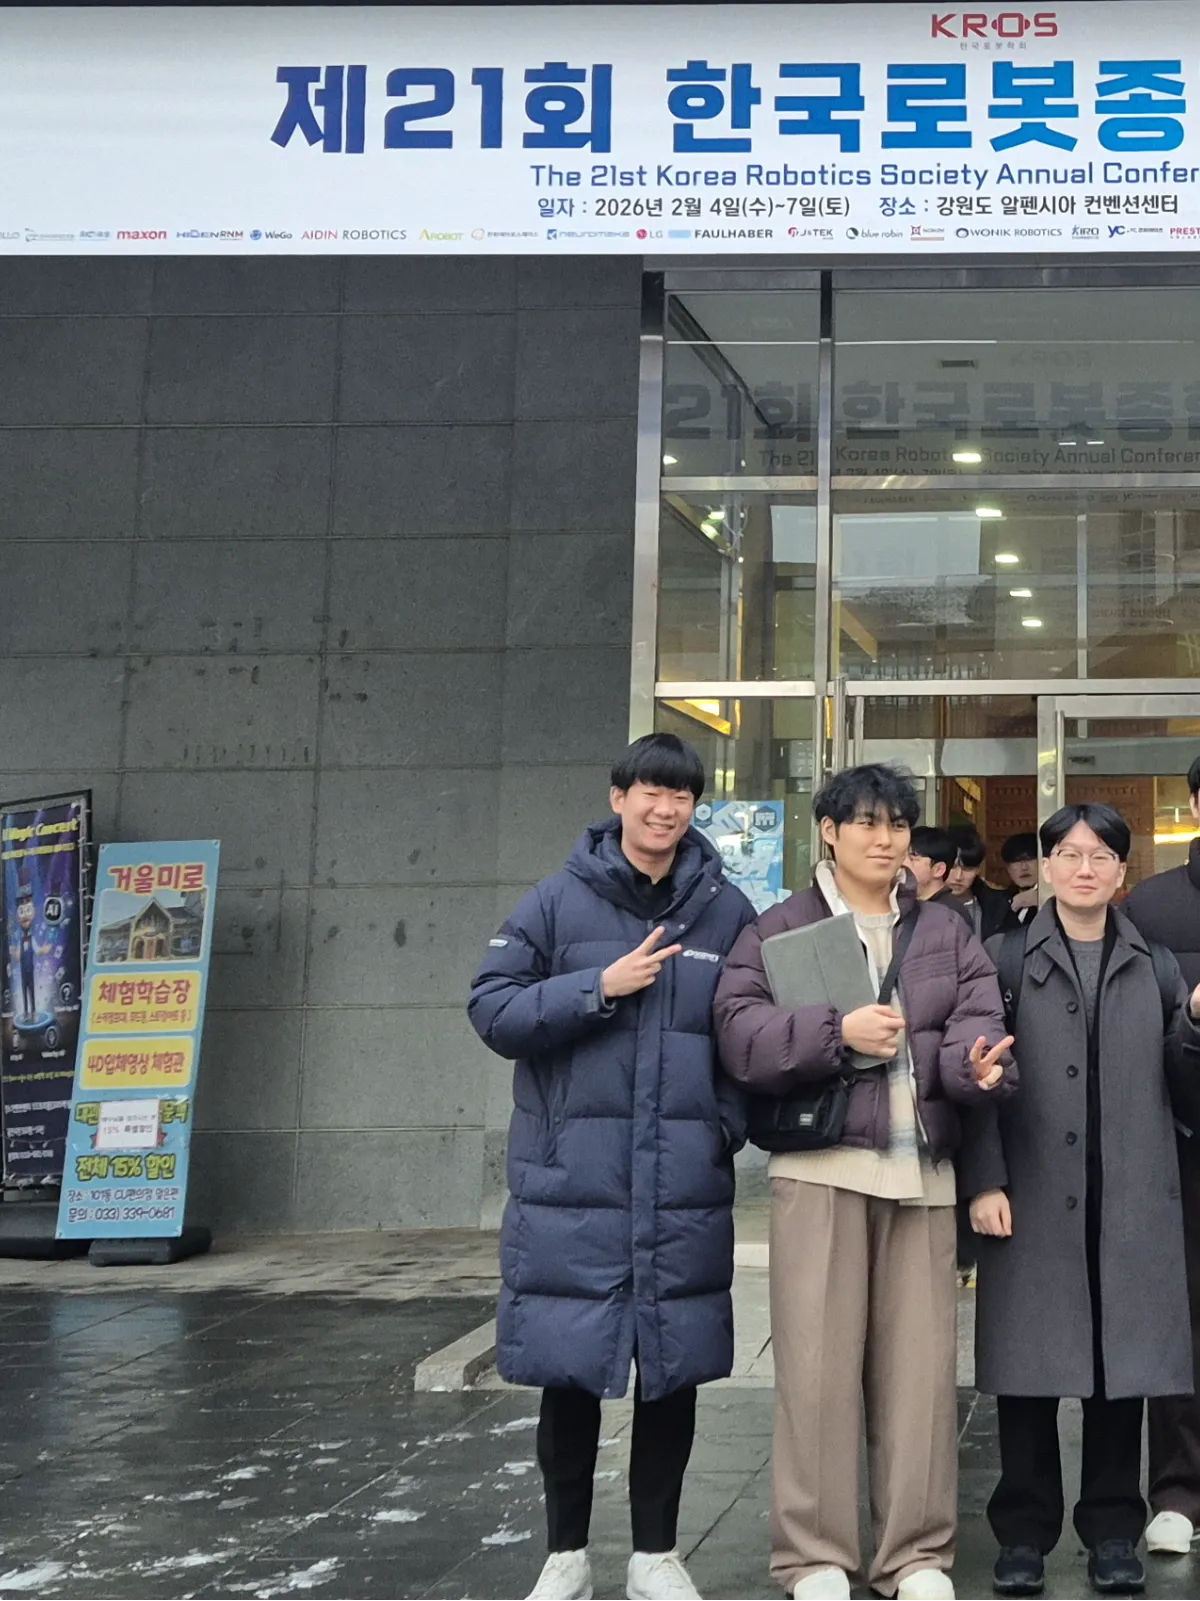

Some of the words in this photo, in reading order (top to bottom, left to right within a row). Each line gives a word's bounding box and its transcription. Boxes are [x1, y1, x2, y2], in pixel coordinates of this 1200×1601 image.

[931, 12, 1058, 39] KROS
[270, 62, 613, 153] 제21회
[529, 164, 582, 187] The
[590, 164, 647, 187] 21st
[656, 164, 737, 187] Korea
[746, 163, 871, 187] Robotics
[880, 162, 989, 190] Society
[995, 161, 1093, 185] Annual
[537, 197, 575, 218] 일자
[595, 198, 663, 217] 2026년
[671, 197, 702, 218] 2월
[709, 196, 850, 219] 4일(수)~7일(토)
[879, 197, 917, 216] 장소
[936, 196, 993, 216] 강원도
[1000, 195, 1077, 216] 알펜시아
[1084, 194, 1178, 215] 컨벤션센터
[116, 229, 168, 240] maxon
[264, 230, 293, 240] WeGo
[301, 229, 338, 240] AIDIN
[342, 229, 408, 240] ROBOTICS
[649, 230, 664, 239] LG
[694, 228, 774, 240] FAULHABER
[860, 229, 878, 238] blue
[880, 229, 904, 238] robin
[969, 228, 1011, 237] WONIK
[1014, 227, 1063, 237] ROBOTICS
[836, 446, 891, 463] Korea
[1053, 444, 1116, 465] Annual
[108, 863, 205, 895] 거울미로
[46, 905, 59, 916] AI
[98, 979, 192, 1006] 체험학습장
[87, 1052, 150, 1076] 4D입체영상
[152, 1051, 186, 1074] 체험관
[76, 1154, 109, 1181] 전체
[110, 1155, 143, 1179] 15%
[144, 1153, 177, 1180] 할인
[68, 1207, 88, 1223] 문의
[95, 1207, 121, 1222] 033)
